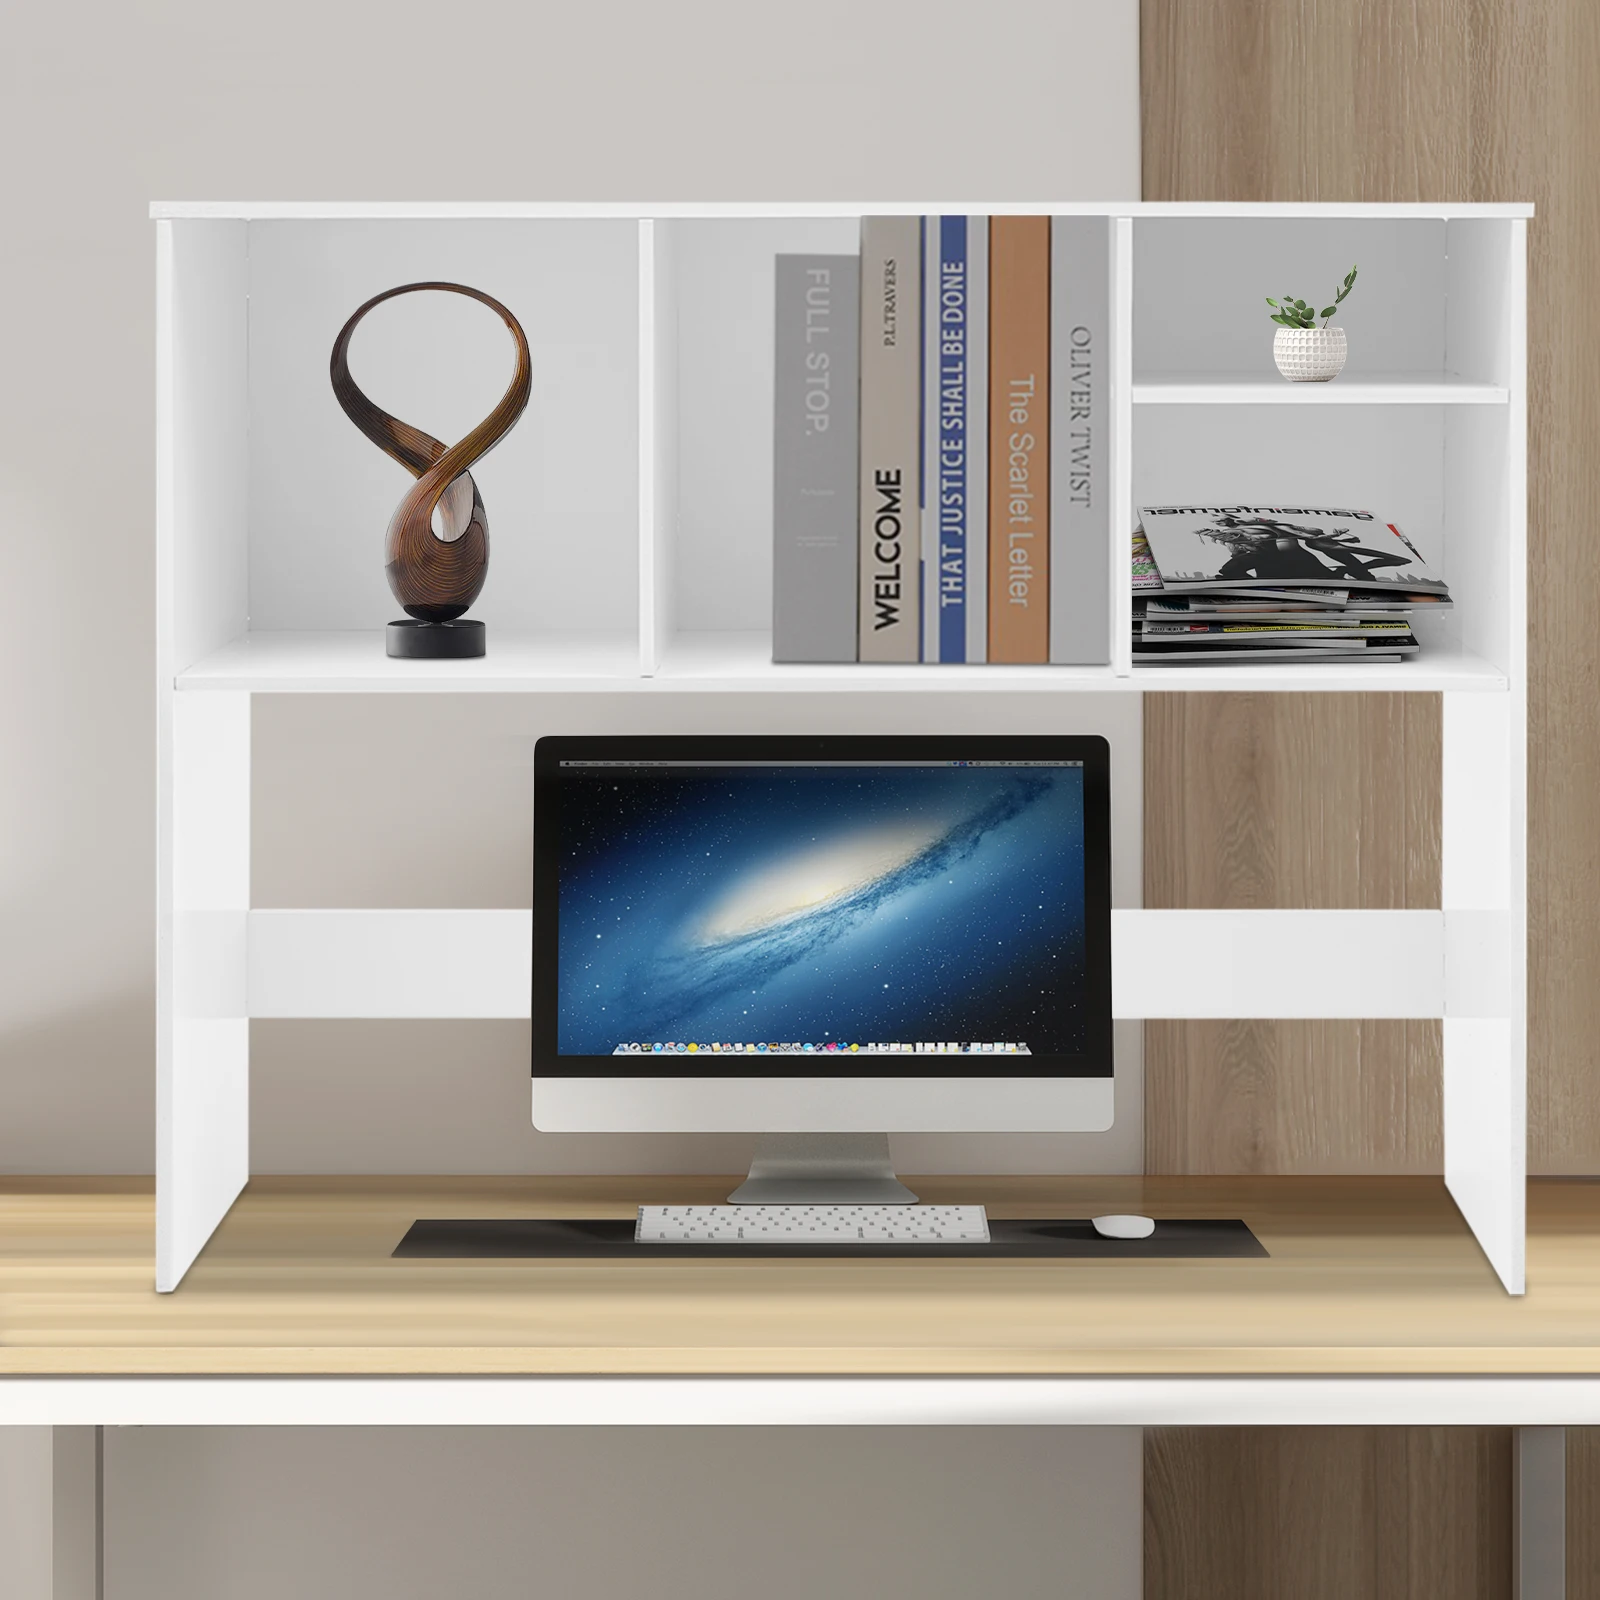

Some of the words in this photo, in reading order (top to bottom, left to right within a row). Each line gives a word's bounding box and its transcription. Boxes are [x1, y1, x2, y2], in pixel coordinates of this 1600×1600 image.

[806, 269, 830, 344] FULL
[942, 262, 963, 323] DONE
[942, 329, 963, 355] BE
[1070, 326, 1091, 421] OLIVER
[806, 352, 830, 436] STOP.
[942, 361, 963, 430] SHALL
[1009, 374, 1034, 424] The
[942, 439, 963, 536] JUSTICE
[1009, 432, 1034, 523] Scarlet
[1070, 427, 1091, 508] TWIST
[874, 469, 901, 631] WELCOME
[942, 544, 963, 607] THAT
[1009, 533, 1034, 607] Letter
